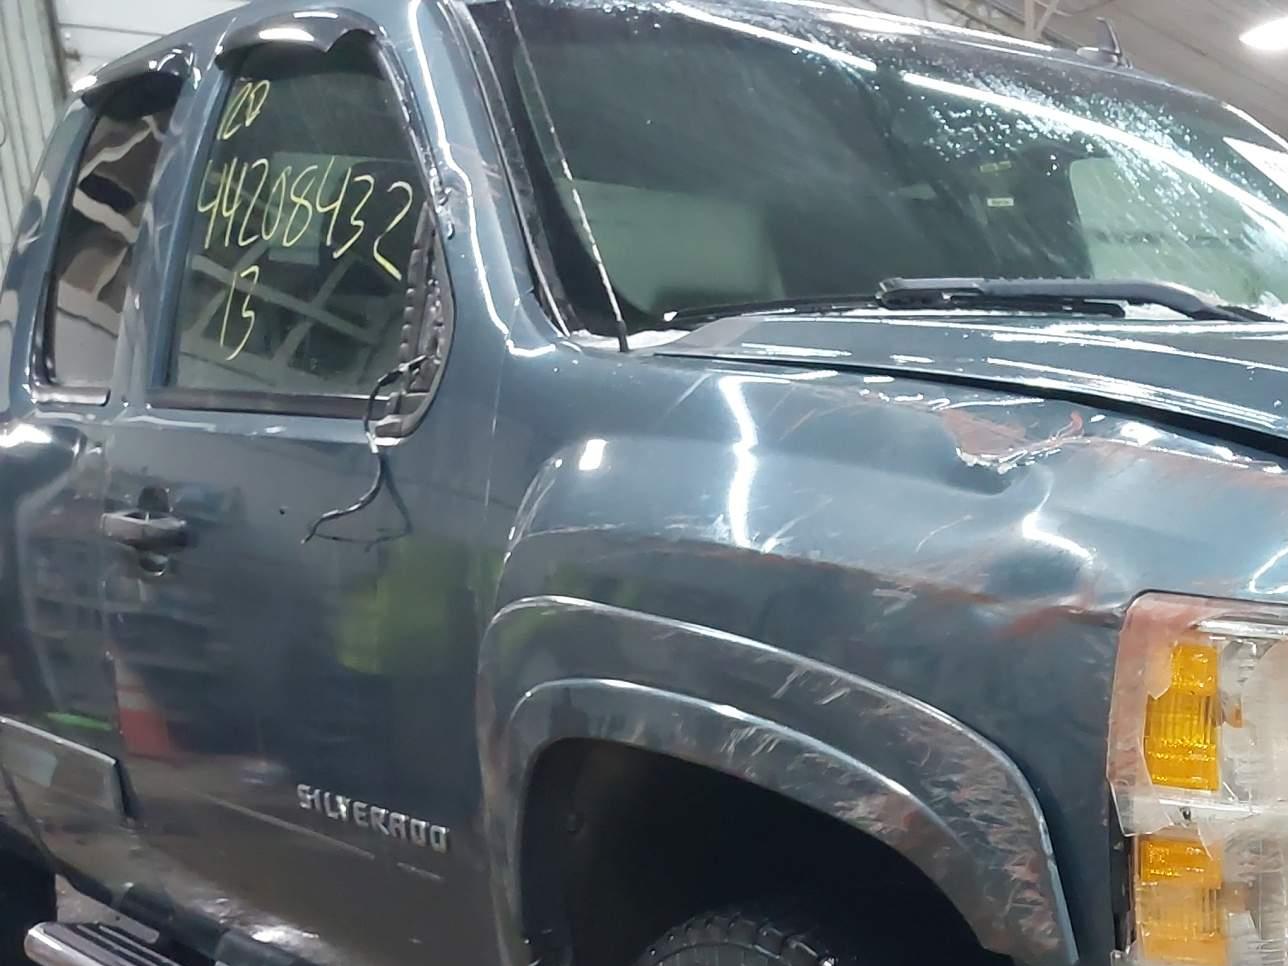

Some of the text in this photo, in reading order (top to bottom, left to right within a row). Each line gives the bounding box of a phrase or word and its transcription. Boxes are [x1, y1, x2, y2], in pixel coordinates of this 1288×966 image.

[197, 156, 414, 281] 44208432
[219, 265, 261, 361] 13
[296, 783, 450, 854] SILVERADO
